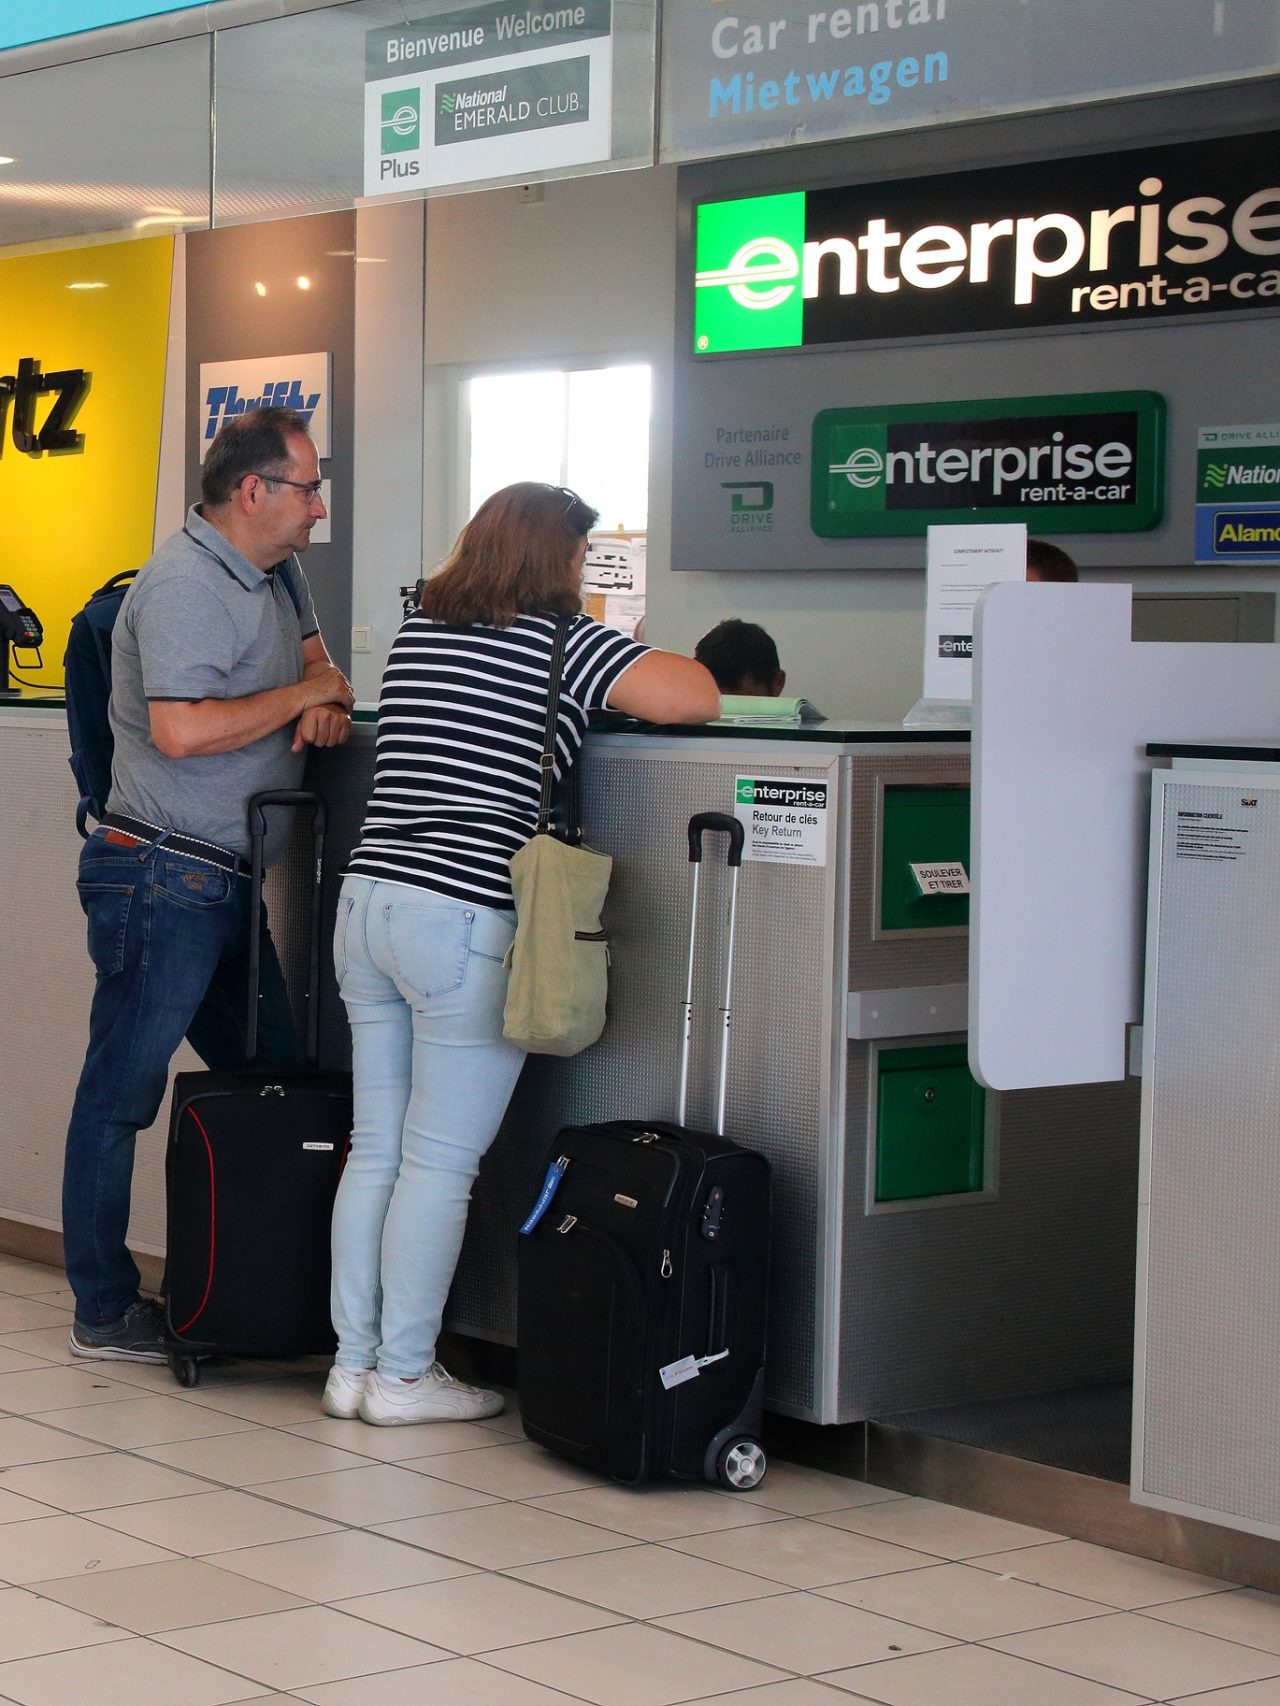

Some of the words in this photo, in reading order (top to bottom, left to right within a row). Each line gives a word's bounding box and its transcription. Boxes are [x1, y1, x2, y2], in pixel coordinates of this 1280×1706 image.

[386, 26, 485, 64] Bienvenue
[495, 5, 587, 41] Welcome
[710, 16, 786, 60] Car
[709, 50, 950, 119] Mietwagen
[454, 85, 508, 111] National
[454, 101, 531, 132] EMERALD
[536, 92, 580, 118] CLUB
[380, 158, 420, 181] Plus
[695, 176, 1280, 310] enterprise
[716, 424, 790, 444] Partenaire
[704, 451, 741, 469] Drive
[745, 449, 802, 467] Alliance
[828, 431, 1133, 496] enterprise
[1226, 464, 1280, 485] Natio
[1020, 483, 1131, 502] rent-a-car
[730, 512, 775, 525] DRIVE
[737, 785, 826, 804] enterprise
[752, 810, 783, 823] Retour
[785, 812, 797, 824] de
[799, 813, 818, 825] clés
[752, 824, 770, 838] Key
[771, 825, 802, 838] Return
[920, 868, 963, 879] SOULEVER
[928, 880, 939, 890] ET
[939, 879, 964, 889] TIRER
